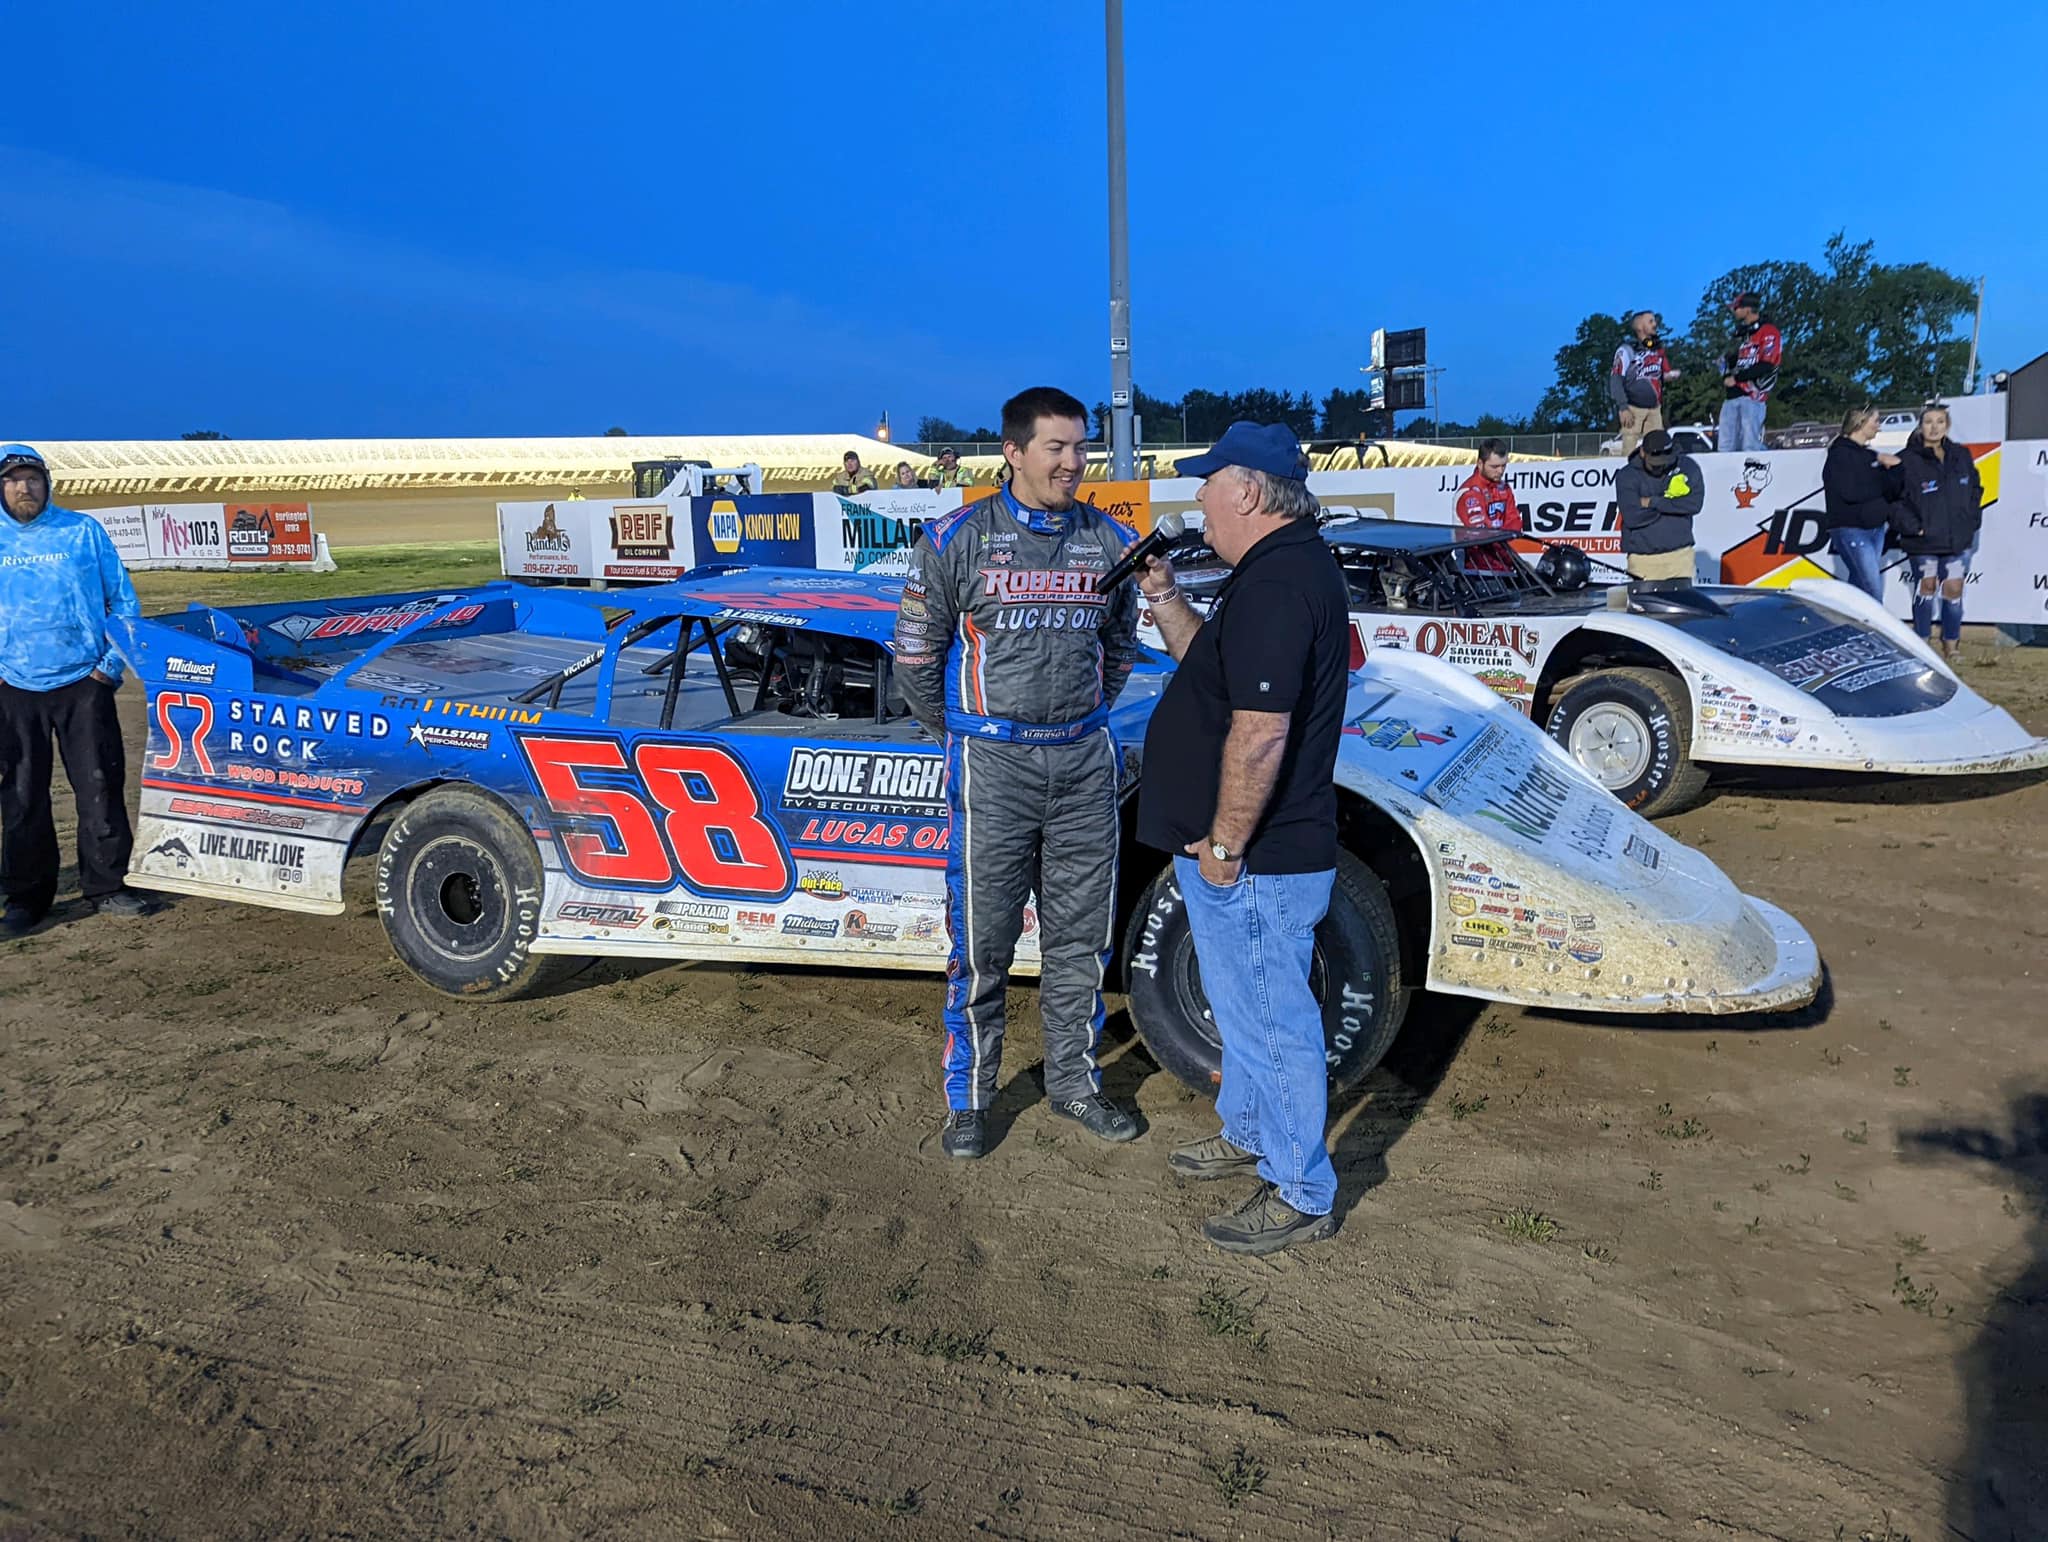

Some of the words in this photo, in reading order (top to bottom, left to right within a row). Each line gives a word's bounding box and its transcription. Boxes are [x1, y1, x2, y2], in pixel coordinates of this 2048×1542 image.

[275, 511, 308, 522] Burlington
[841, 504, 872, 516] FRANK
[189, 520, 220, 546] 107.3
[620, 514, 662, 540] REIF
[713, 514, 738, 538] NAPA
[744, 514, 774, 540] KNOW
[777, 514, 800, 540] HOW
[229, 530, 269, 544] ROTH
[272, 544, 311, 554] 319-752-0741
[634, 548, 660, 557] COMPANY
[844, 552, 864, 565] AND
[522, 564, 578, 574] 309-627-2500
[714, 608, 808, 626] ALBERSON
[995, 608, 1067, 630] LUCAS
[1071, 608, 1100, 629] OIL
[1450, 647, 1498, 657] SALVAGE
[1503, 649, 1512, 658] &
[1450, 656, 1512, 667] RECYCLING
[166, 657, 216, 676] Midwest
[563, 653, 596, 678] VICTORY
[228, 700, 390, 737] STARVED
[424, 726, 490, 740] ALLSTAR
[230, 732, 319, 763] ROCK
[424, 738, 488, 750] PERFORMANCE
[1649, 712, 1671, 788] Hoosier
[227, 764, 276, 784] WOOD
[278, 768, 364, 796] PRODUCTS
[791, 752, 868, 794] DONE
[1436, 763, 1465, 794] ROBERTS
[520, 736, 788, 893] 58
[784, 799, 804, 808] TV
[816, 800, 912, 815] SECURITY
[801, 819, 908, 847] LUCAS
[200, 832, 304, 868] LIVE.KLAFF.LOVE
[801, 877, 842, 891] Out-Pace
[851, 888, 892, 898] QUARTER
[858, 894, 894, 904] MASTER
[561, 904, 644, 922] CAPITAL
[682, 902, 730, 920] PRAXAIR
[736, 910, 776, 924] PEM
[784, 915, 838, 931] Midwest
